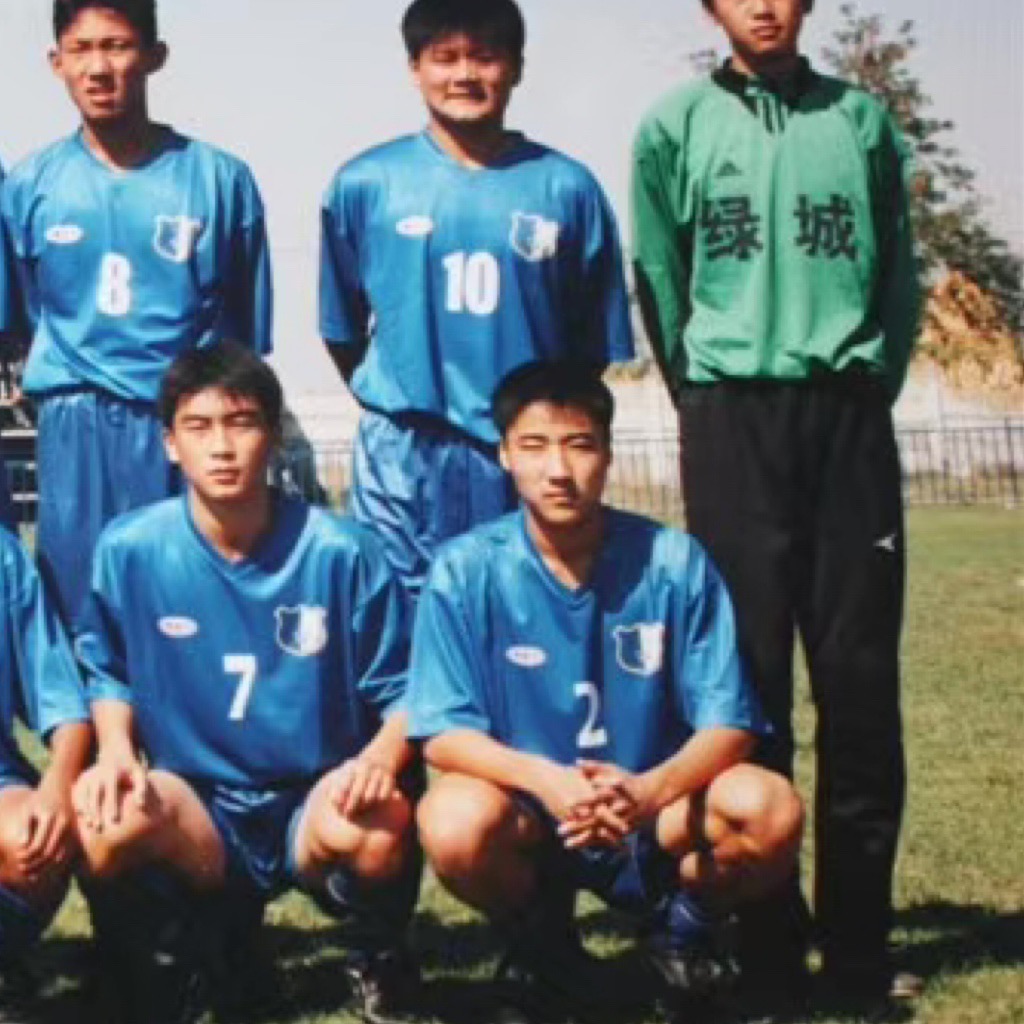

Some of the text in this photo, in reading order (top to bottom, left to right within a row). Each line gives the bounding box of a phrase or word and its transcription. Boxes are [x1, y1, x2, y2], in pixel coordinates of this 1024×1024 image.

[700, 193, 857, 261] 绿城
[95, 252, 134, 317] 8
[442, 251, 500, 315] 10
[224, 655, 257, 719] 7
[575, 683, 607, 748] 2
